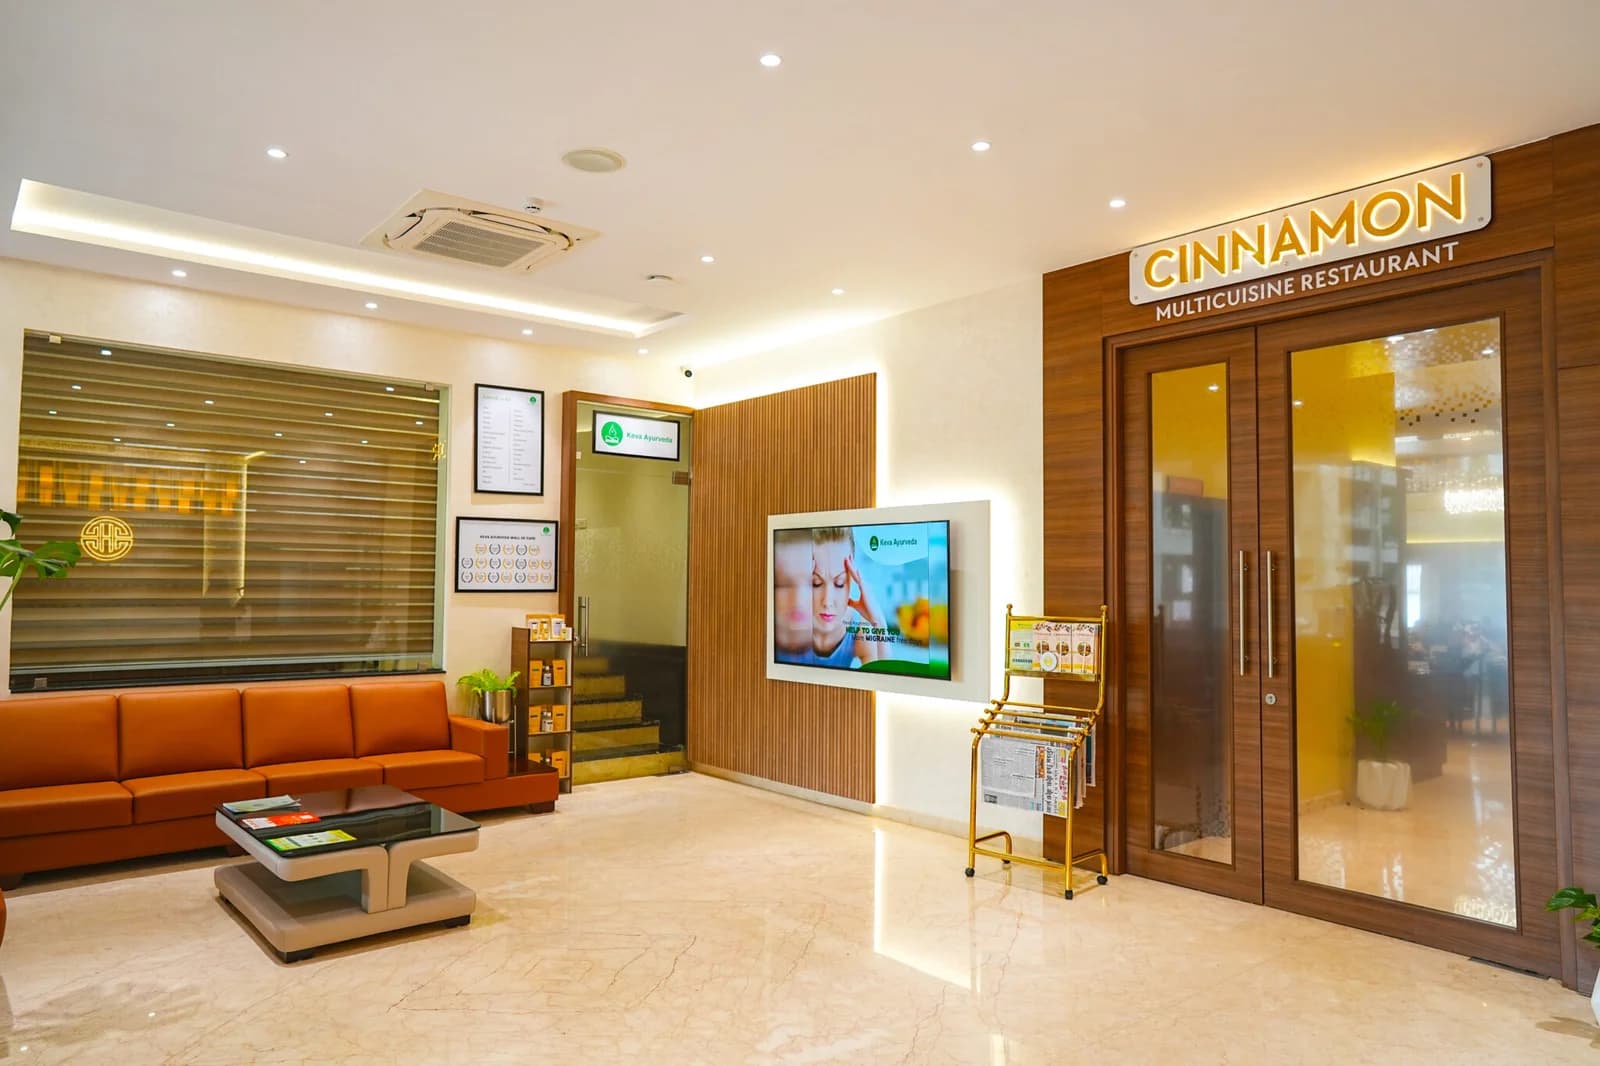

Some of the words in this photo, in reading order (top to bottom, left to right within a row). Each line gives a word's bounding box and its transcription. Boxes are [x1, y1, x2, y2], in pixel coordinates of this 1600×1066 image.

[1142, 172, 1466, 290] CINNAMON
[1155, 278, 1294, 322] MULTICUISINE
[1301, 241, 1459, 290] RESTAURANT
[643, 432, 673, 444] Ayurveda
[880, 538, 892, 546] Keva
[894, 538, 917, 547] Ayurveda
[846, 625, 860, 634] HELP
[871, 627, 886, 635] GIVE
[887, 628, 901, 636] YOU
[865, 635, 896, 643] MIGRAINE
